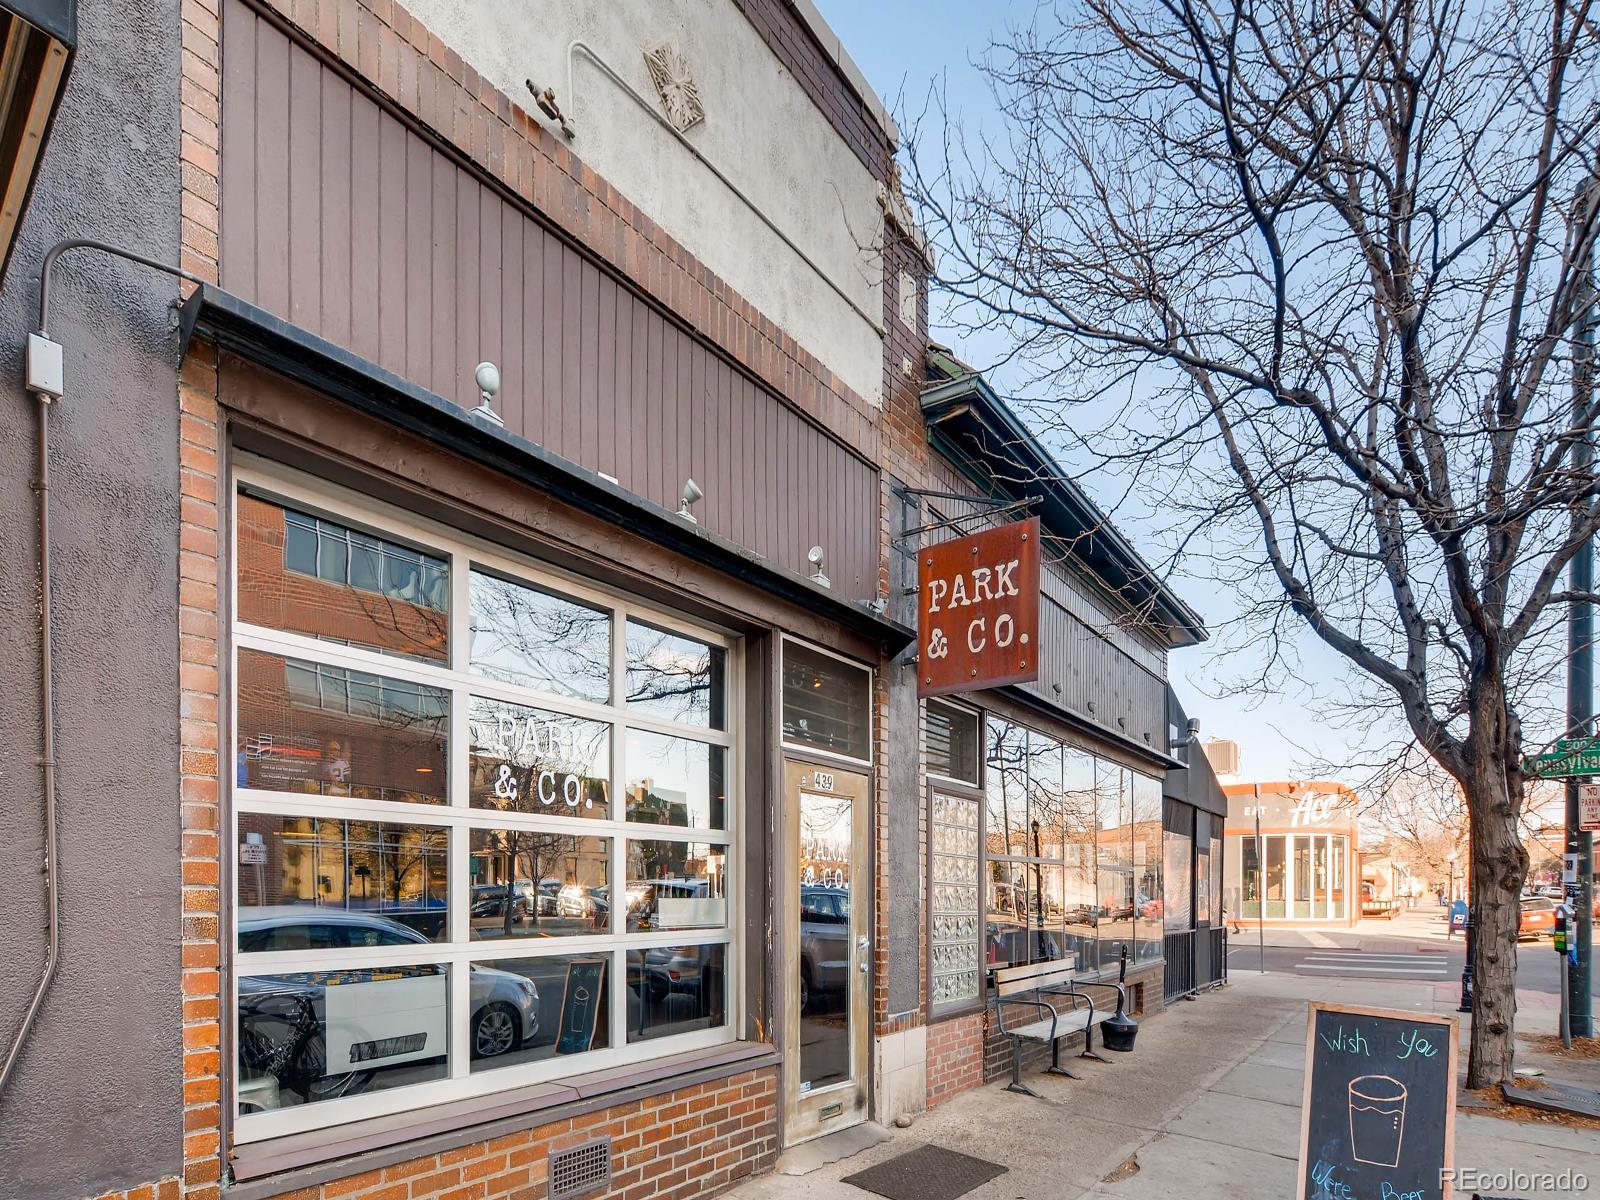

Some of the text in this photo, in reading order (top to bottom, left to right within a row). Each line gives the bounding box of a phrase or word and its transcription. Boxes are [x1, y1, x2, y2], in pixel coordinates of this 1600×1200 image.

[928, 559, 1019, 614] PARK
[927, 613, 1029, 660] & CO.
[494, 713, 590, 766] PARK
[494, 764, 593, 809] & CO.
[815, 773, 833, 790] 439
[1587, 787, 1598, 796] NO
[804, 836, 848, 862] PARK
[804, 865, 849, 890] & CO.
[1320, 1025, 1370, 1057] Wish
